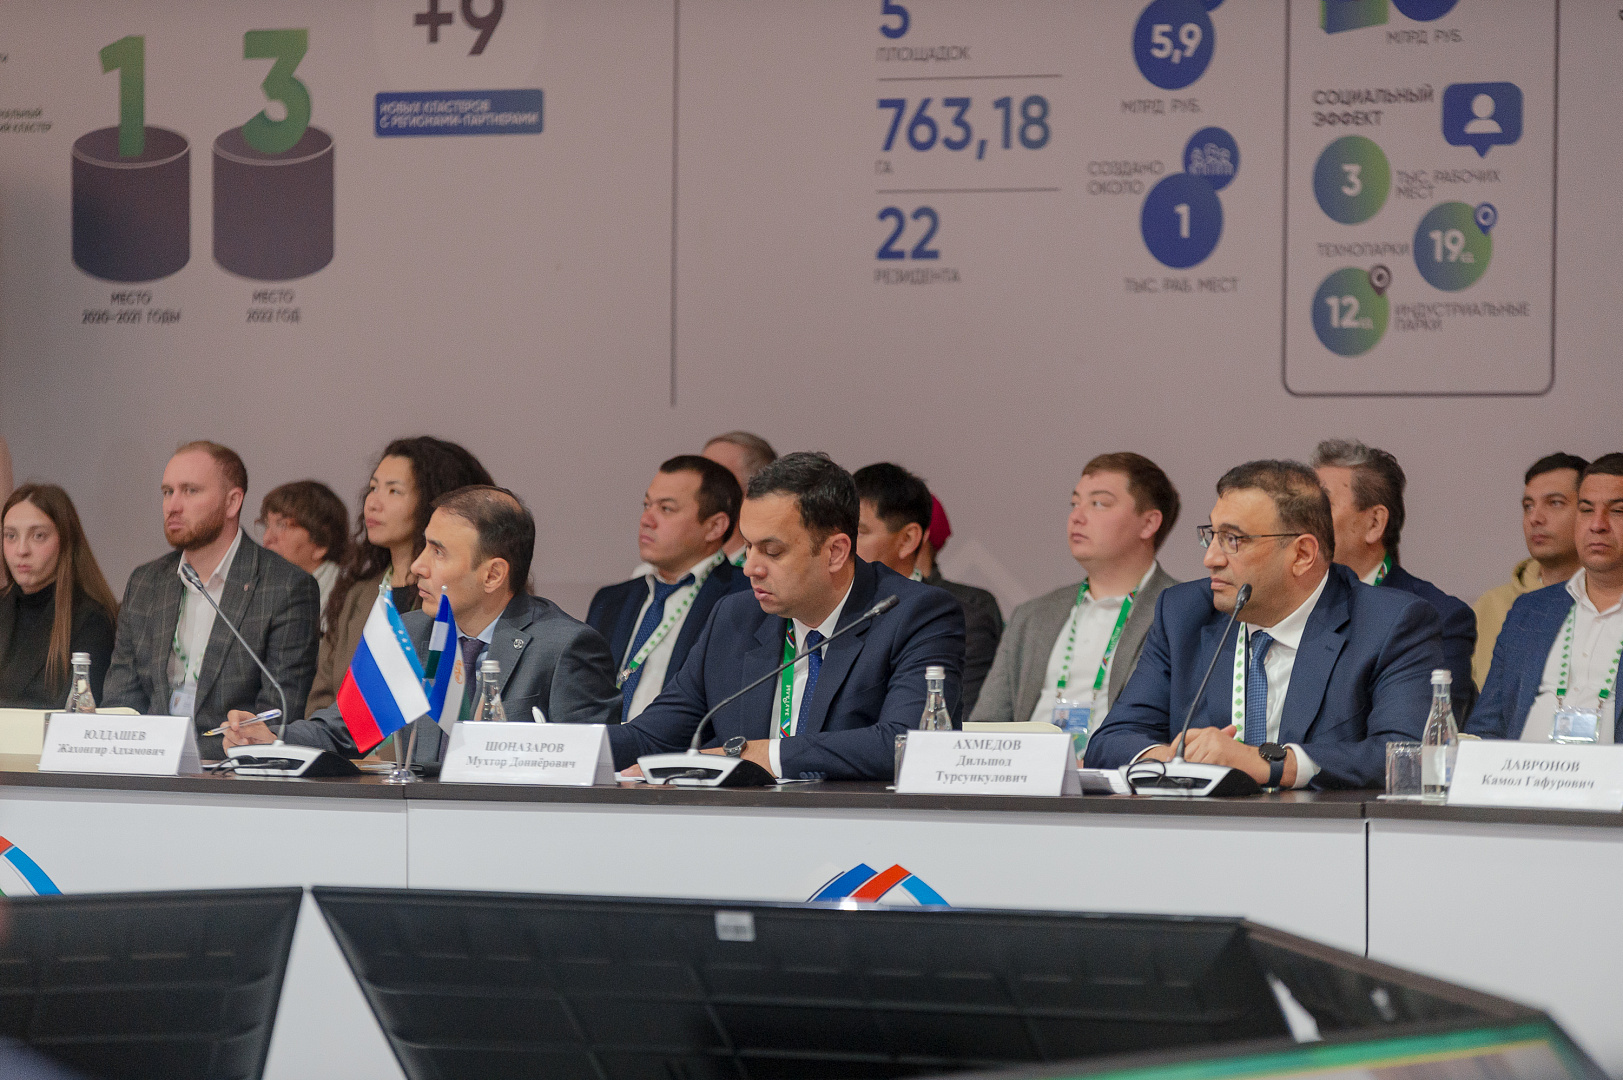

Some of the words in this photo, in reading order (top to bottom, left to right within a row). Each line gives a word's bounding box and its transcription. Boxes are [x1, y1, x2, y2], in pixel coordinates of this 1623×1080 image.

[879, 0, 911, 39] 5
[1150, 23, 1202, 64] 5,9
[876, 46, 971, 62] ПЛОЩАДОК
[98, 35, 145, 157] 1
[242, 28, 312, 154] 3
[1313, 84, 1434, 106] СОЦИАЛЬНЫЙ
[380, 102, 420, 114] НОВЫХ
[423, 99, 491, 113] КЛАСТЕРОВ
[1313, 111, 1383, 127] ЭФФЕКТ
[876, 95, 1051, 160] 763,18
[1087, 160, 1164, 176] СОЗДАНО
[1087, 180, 1145, 195] ОКОЛО
[1341, 163, 1362, 197] 3
[1173, 203, 1191, 239] 1
[875, 206, 940, 260] 22
[1317, 241, 1410, 257] ТЕХНОПАРКИ
[1429, 229, 1465, 263] 19
[873, 268, 961, 284] РЕЗИДЕНТА
[1199, 277, 1238, 293] МЕСТ
[111, 291, 151, 305] МЕСТО
[252, 290, 294, 304] МЕСТО
[147, 308, 181, 324] ГОДЫ
[246, 308, 272, 323] 2022
[276, 307, 300, 323] ГОД
[1326, 295, 1361, 329] 12
[84, 729, 147, 741] ЮЛДАШЕВ
[485, 741, 565, 753] ШОНАЗАРОВ
[953, 739, 1021, 751] АХМЕДОВ
[466, 756, 507, 769] Мухтор
[509, 757, 576, 770] Дониёрович
[956, 755, 1012, 767] Дильшод
[1501, 759, 1580, 773] ДАВРОНОВ
[936, 770, 1028, 784] Турсункулович
[1481, 774, 1522, 787] Камол
[1525, 775, 1595, 790] Гафурович
